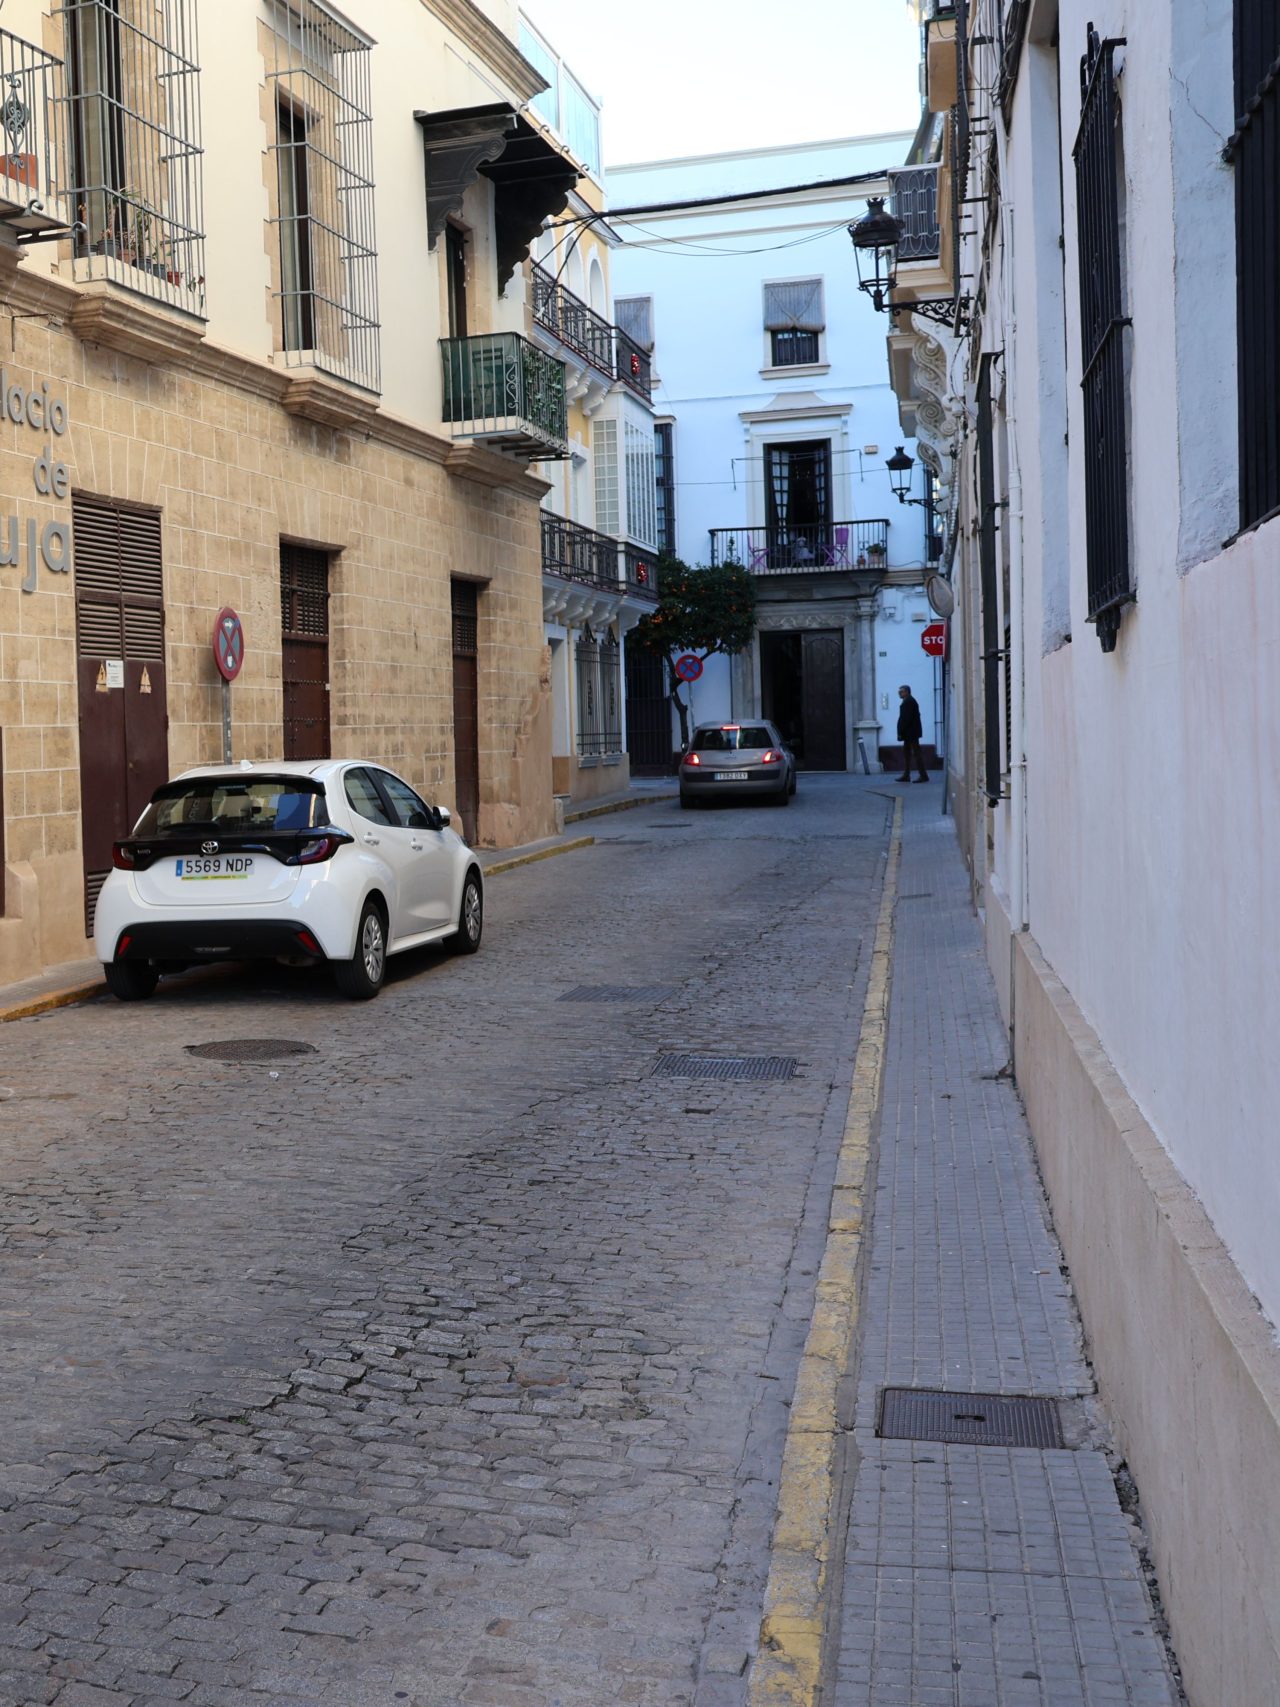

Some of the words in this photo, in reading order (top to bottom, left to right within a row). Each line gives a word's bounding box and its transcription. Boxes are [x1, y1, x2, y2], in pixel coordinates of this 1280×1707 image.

[34, 447, 69, 499] de
[923, 636, 945, 645] STO
[185, 859, 221, 873] 5569
[226, 858, 253, 872] NDP
